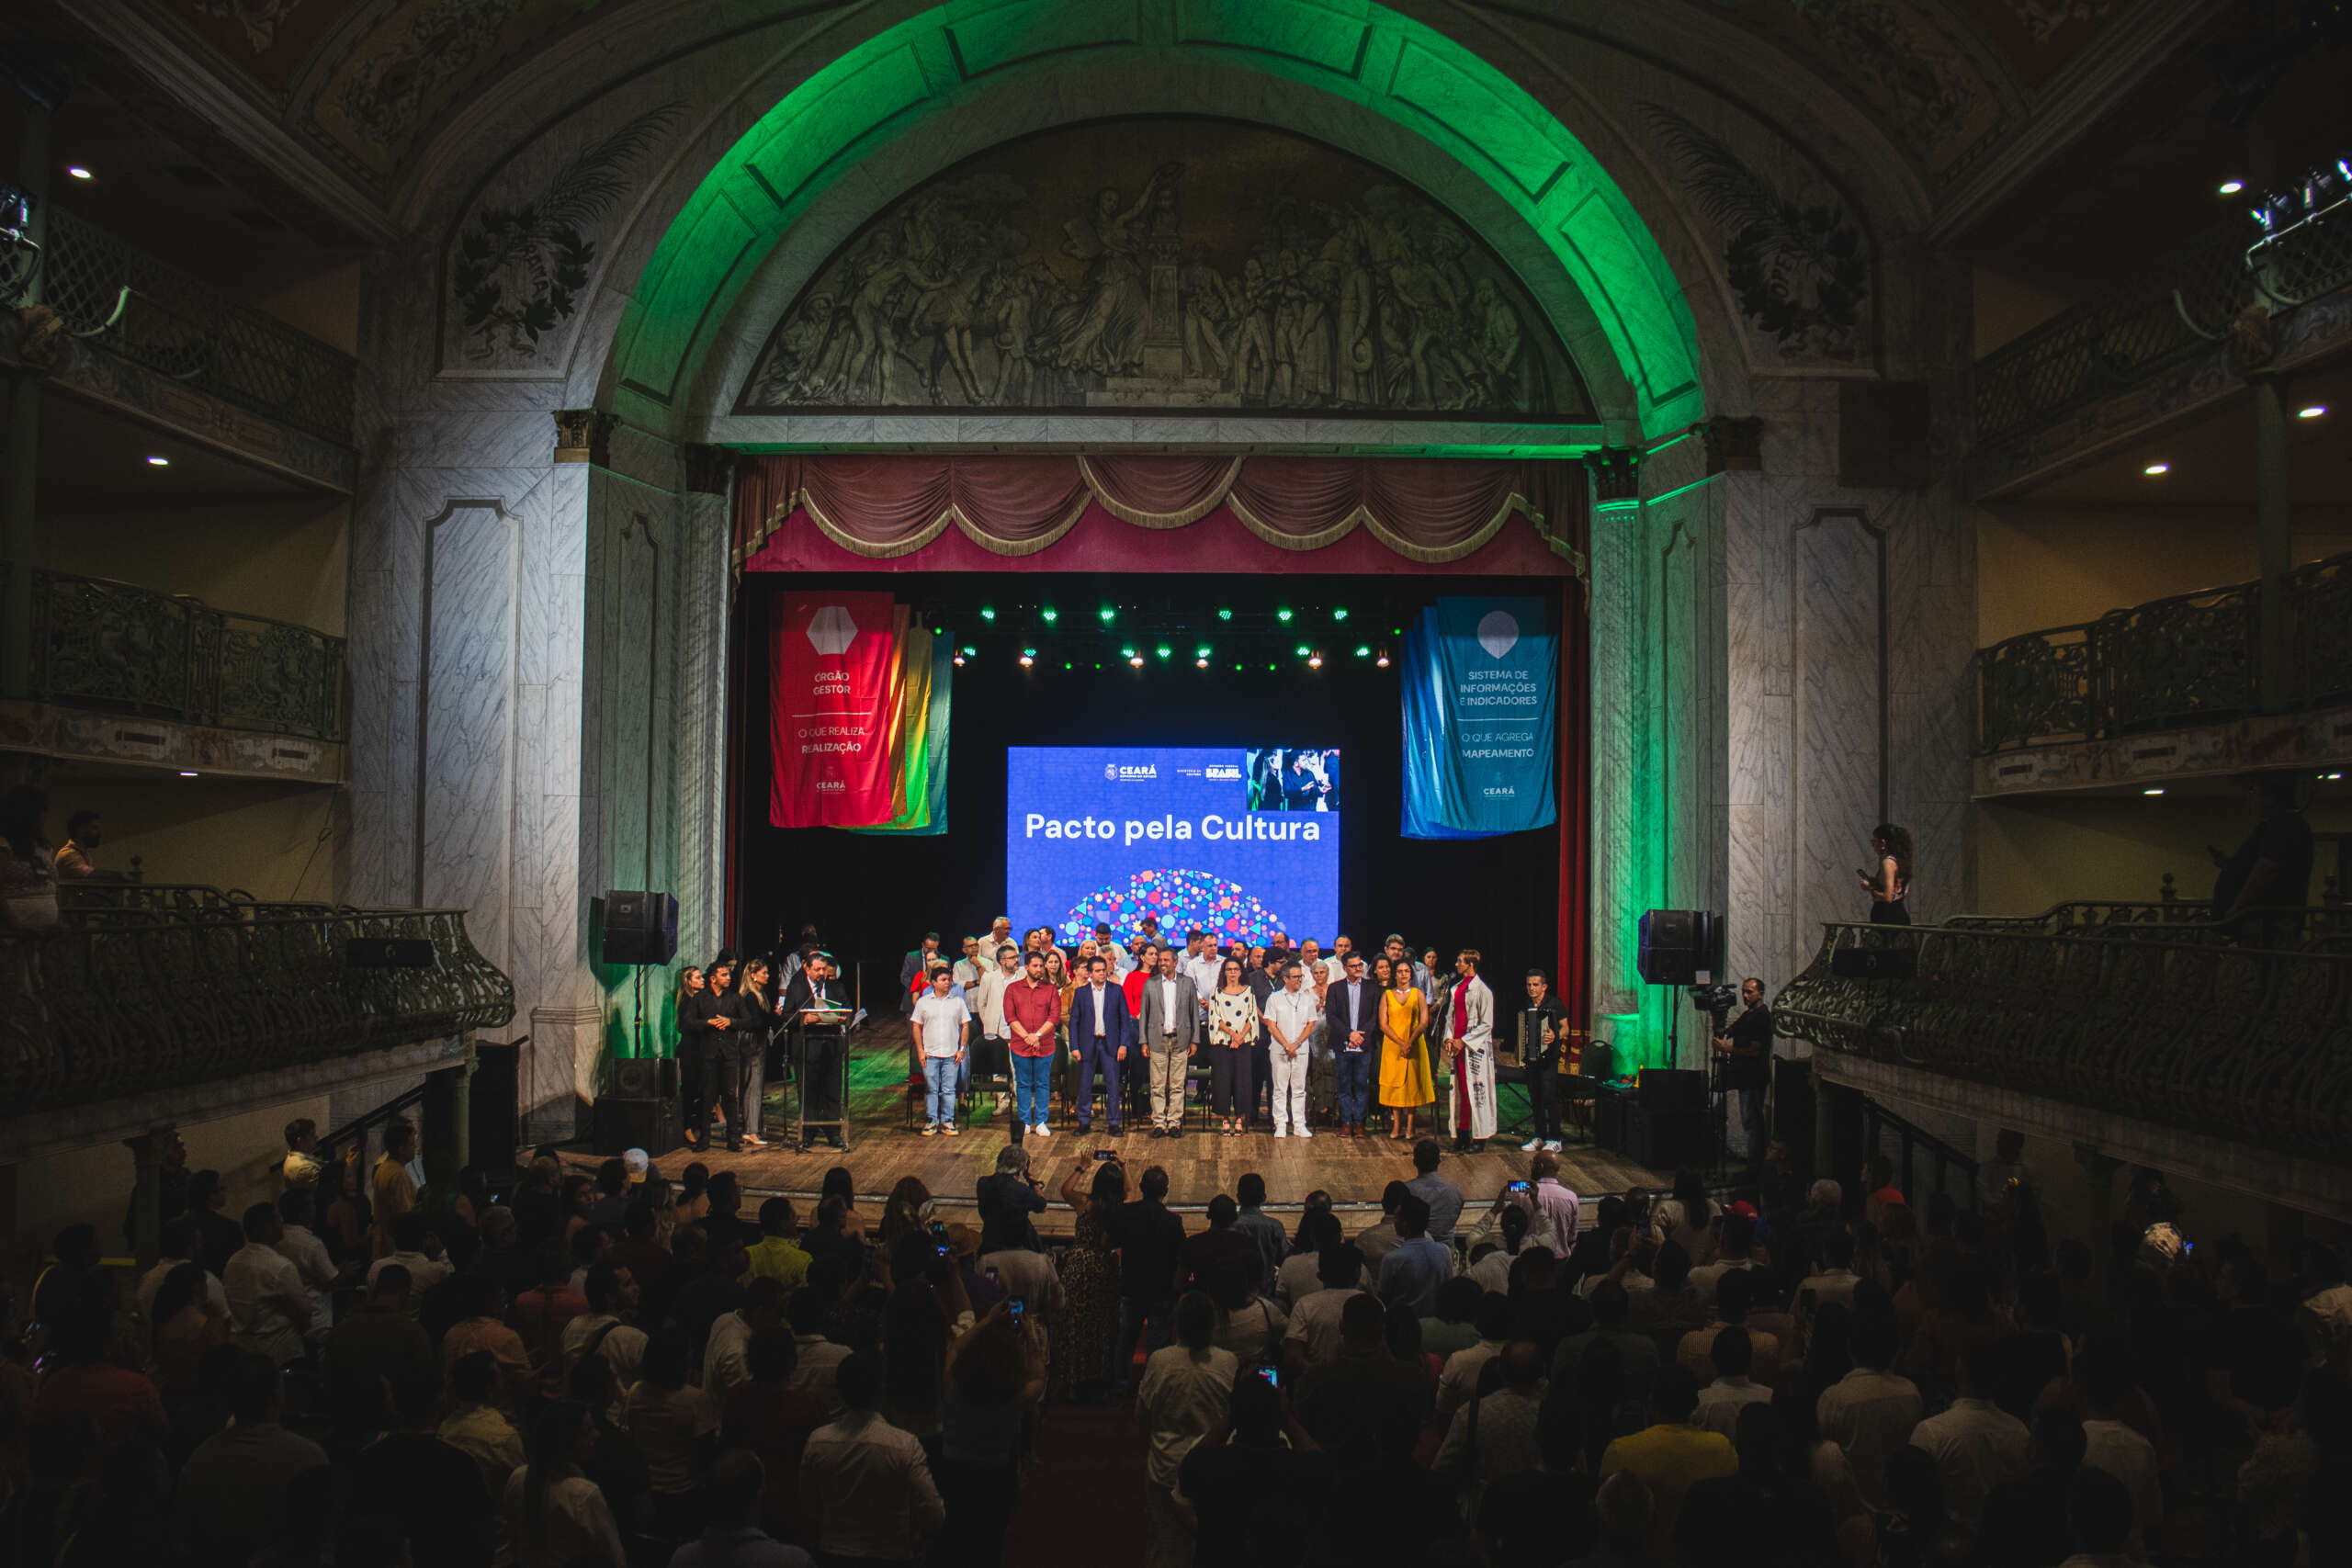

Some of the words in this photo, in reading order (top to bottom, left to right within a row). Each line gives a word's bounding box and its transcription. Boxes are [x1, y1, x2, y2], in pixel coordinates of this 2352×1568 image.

[1468, 671, 1512, 681] SISTEMA
[1514, 671, 1529, 680] DE
[813, 684, 851, 695] GESTOR
[1460, 682, 1537, 694] INFORMAÇÕES
[1459, 697, 1465, 705] E
[1467, 696, 1537, 705] INDICADORES
[798, 728, 808, 739] O
[829, 727, 865, 736] REALIZA
[1462, 733, 1470, 742] O
[1472, 733, 1492, 742] QUE
[1495, 732, 1533, 742] AGREGA
[801, 740, 862, 755] REALIZAÇÃO
[1462, 748, 1534, 758] MAPEAMENTO
[1119, 763, 1157, 775] CEARÁ
[816, 779, 846, 789] CEARÁ
[1483, 785, 1515, 795] CEARÁ
[1026, 813, 1115, 840] Pacto
[1125, 814, 1193, 846] pela
[1201, 815, 1321, 840] Cultura
